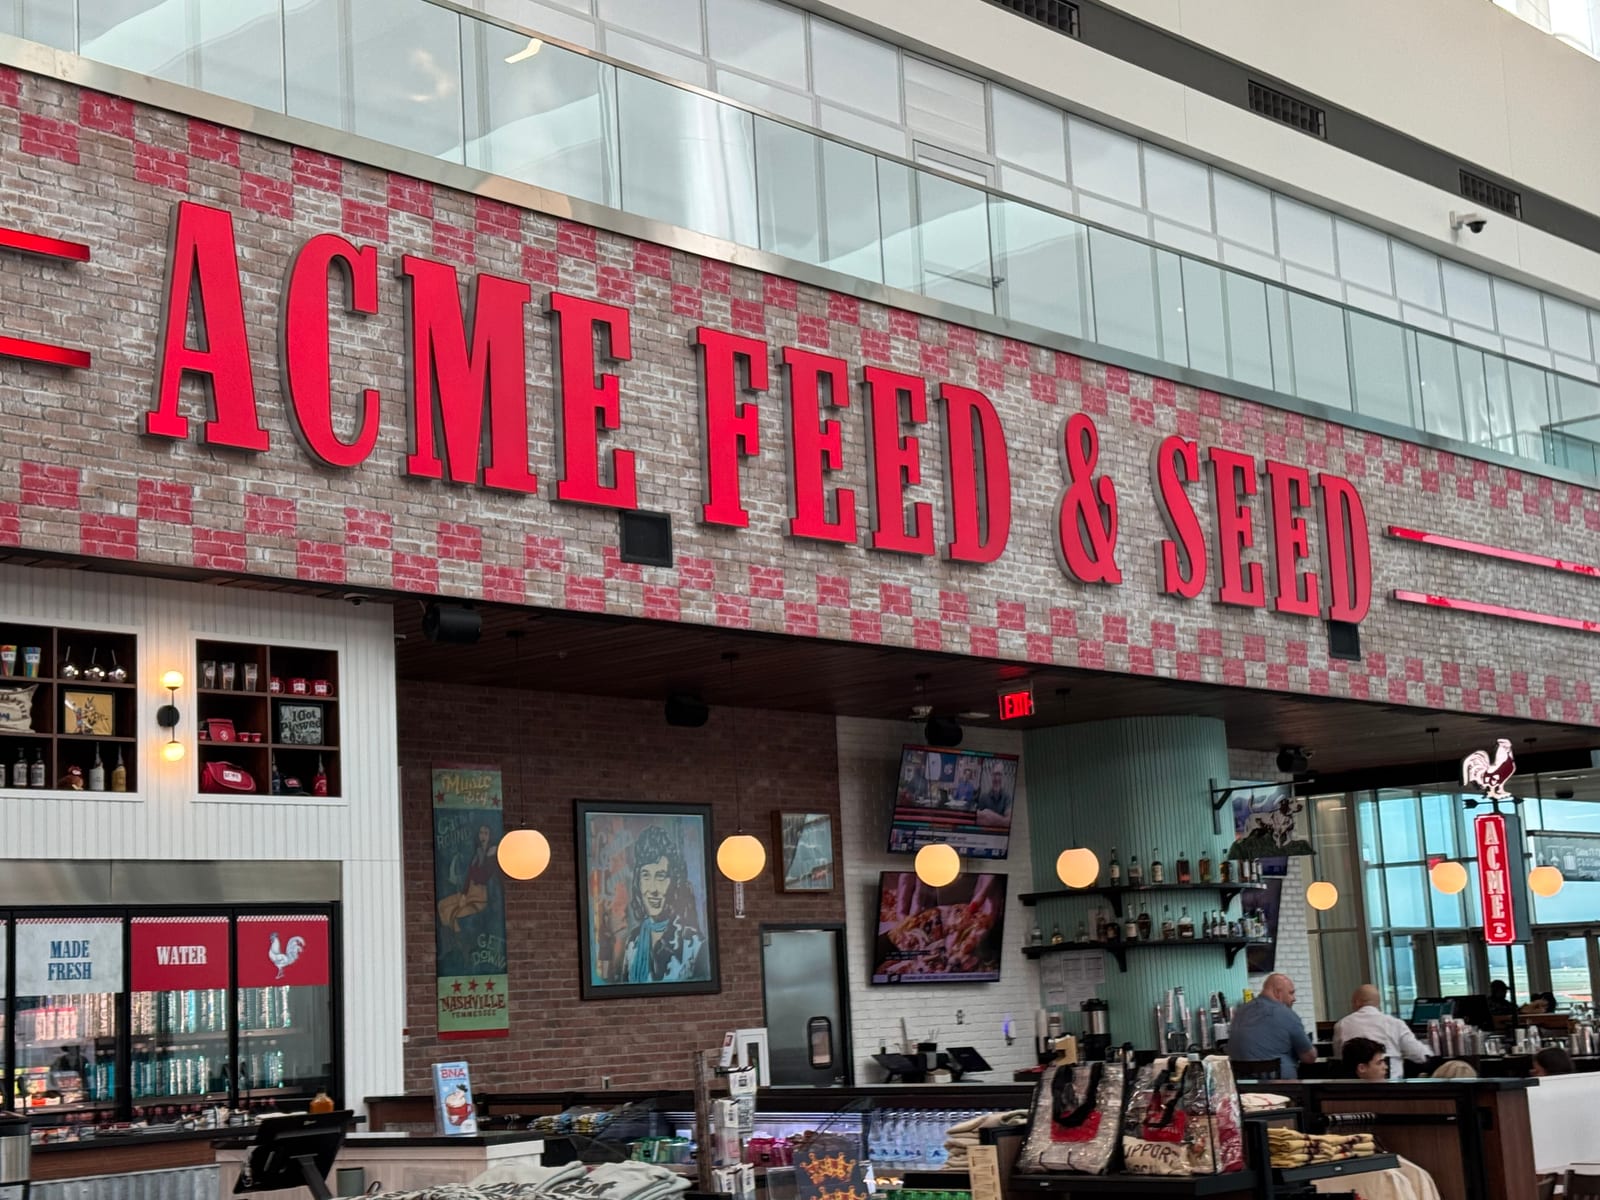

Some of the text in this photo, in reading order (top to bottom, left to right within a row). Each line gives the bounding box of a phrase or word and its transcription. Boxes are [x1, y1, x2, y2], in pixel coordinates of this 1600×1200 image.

[145, 199, 1372, 625] ACME FEED & SEED
[1004, 692, 1031, 718] EXIT
[1483, 820, 1506, 920] ACME
[49, 940, 90, 959] MADE
[156, 945, 207, 965] WATER
[47, 961, 92, 981] FRESH
[440, 993, 506, 1012] NASHVILLE
